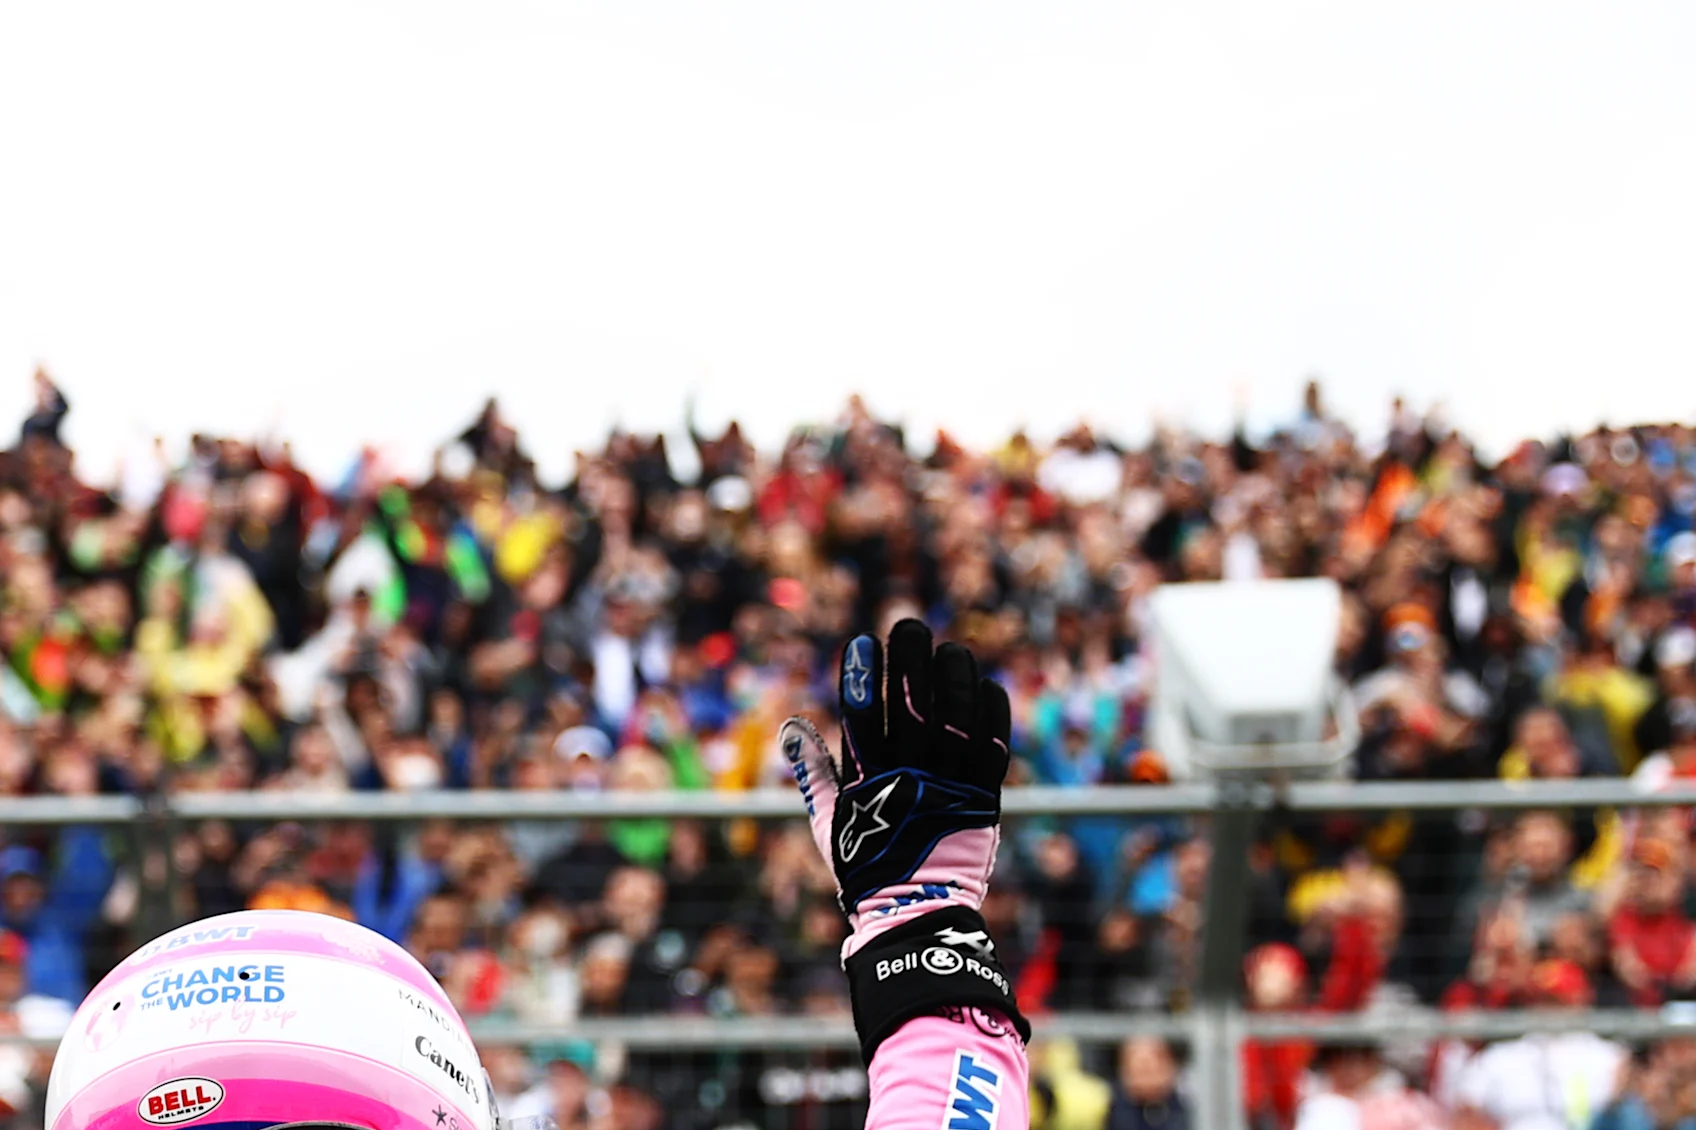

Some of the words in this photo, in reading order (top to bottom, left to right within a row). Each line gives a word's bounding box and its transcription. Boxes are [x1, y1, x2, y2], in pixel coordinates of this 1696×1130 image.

[166, 925, 255, 950] BWT
[875, 952, 918, 982] Bell
[141, 965, 286, 999] CHANGE
[140, 997, 165, 1011] THE
[166, 985, 286, 1011] WORLD
[189, 1010, 223, 1035] sip
[230, 994, 257, 1034] by
[262, 1004, 298, 1030] sip
[157, 1105, 205, 1120] HELMETS
